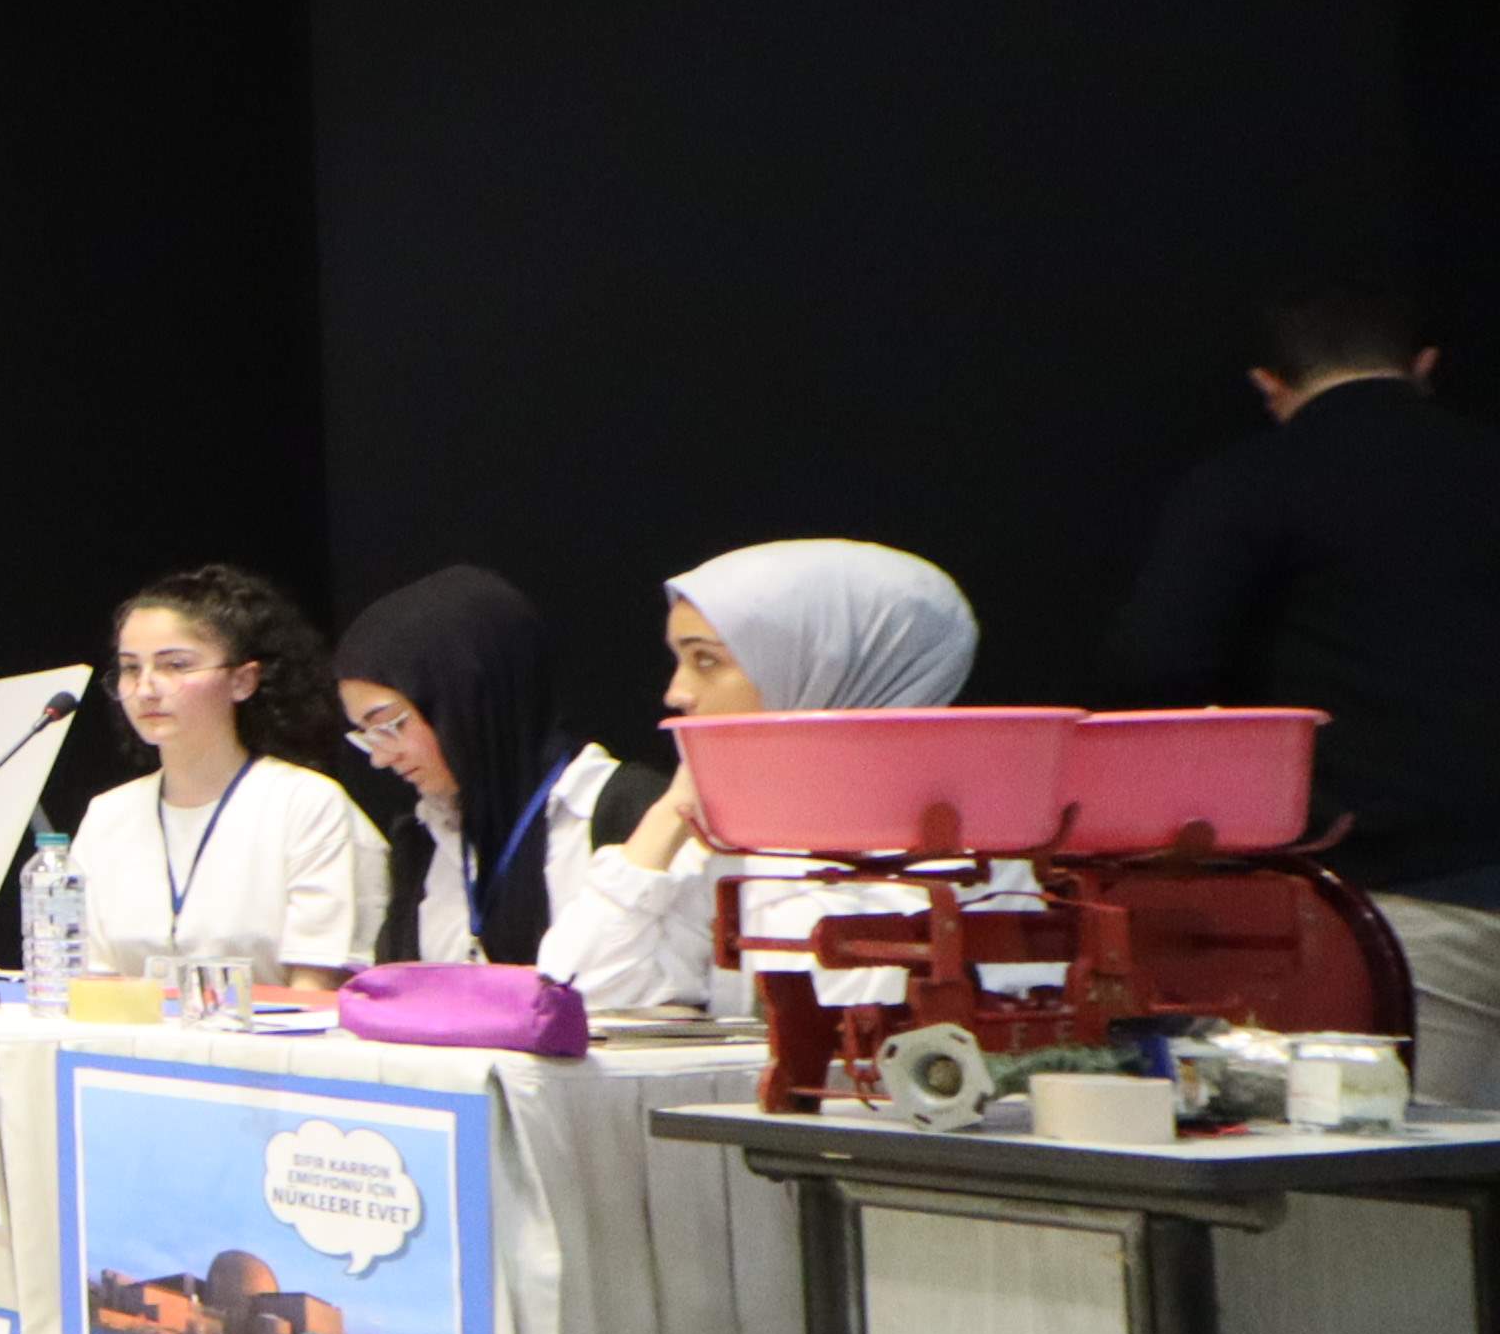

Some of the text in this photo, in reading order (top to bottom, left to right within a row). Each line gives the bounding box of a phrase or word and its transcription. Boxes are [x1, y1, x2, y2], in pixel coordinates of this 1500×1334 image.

[293, 1153, 392, 1180] SIFIR KARBON
[287, 1170, 364, 1194] EMİSYONU
[271, 1185, 412, 1225] NÜKLEERE EVET
